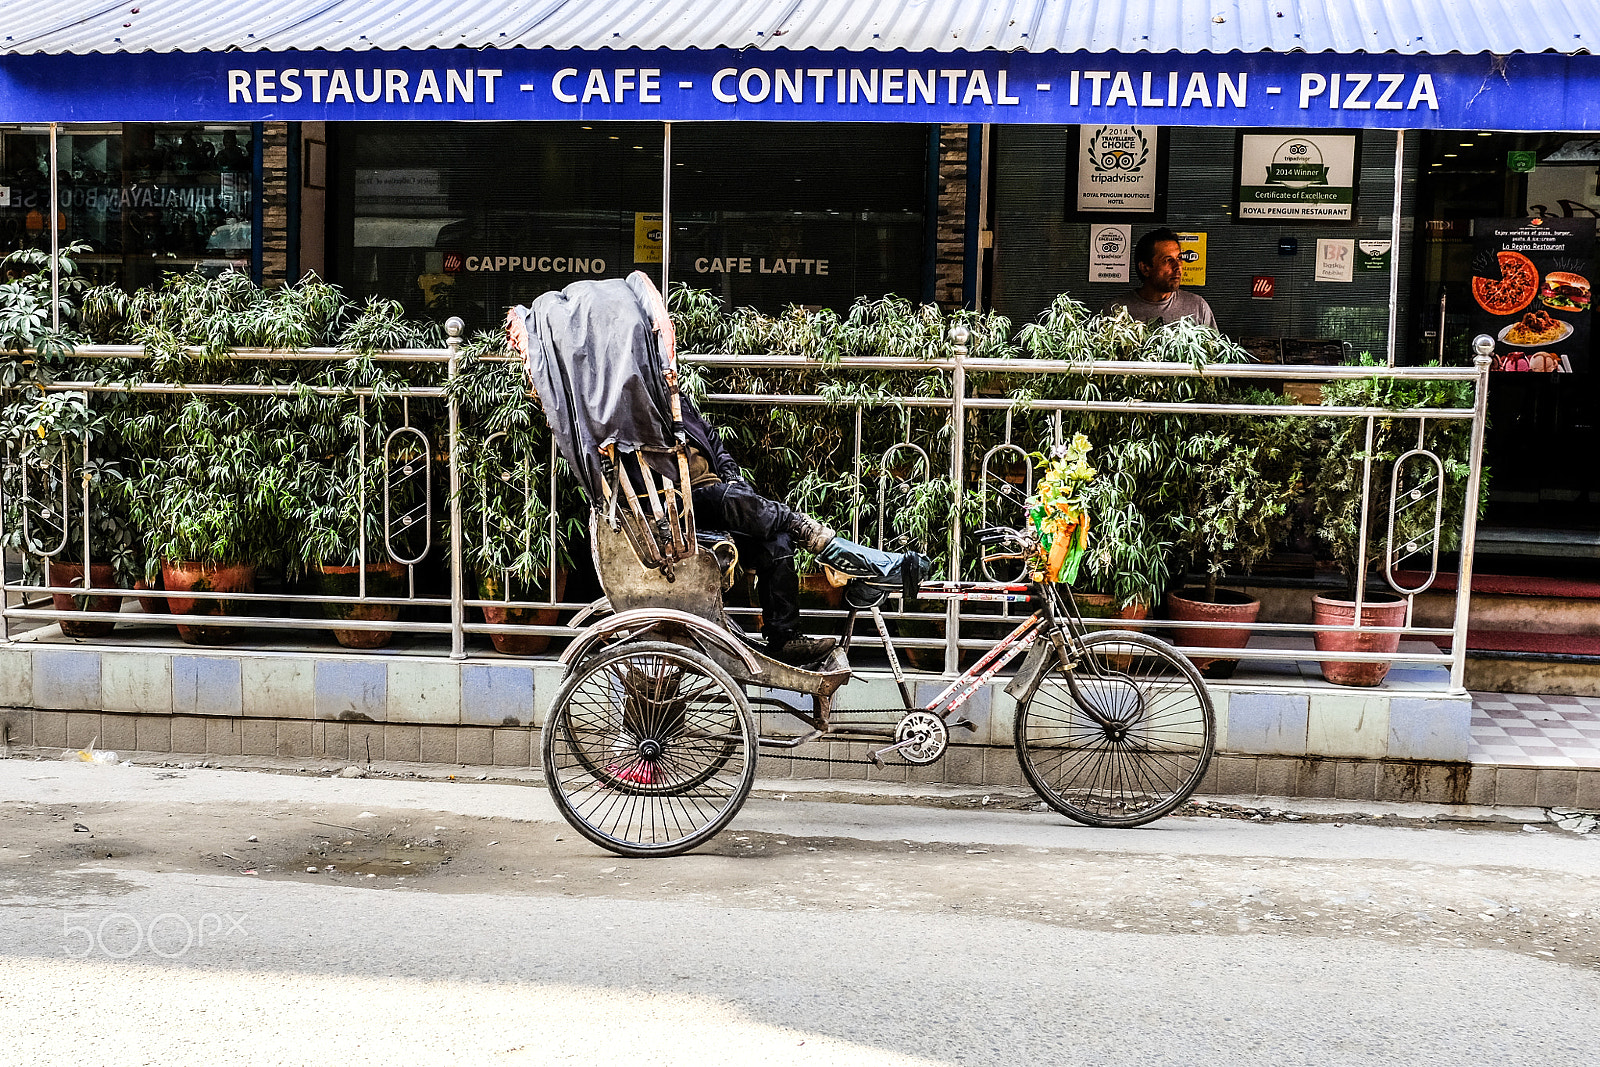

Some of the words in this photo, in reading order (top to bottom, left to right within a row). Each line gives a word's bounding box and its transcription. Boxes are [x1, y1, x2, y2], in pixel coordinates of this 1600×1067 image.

[228, 69, 503, 104] RESTAURANT
[551, 68, 662, 103] CAFE
[711, 68, 1019, 106] CONTINENTAL
[1069, 70, 1248, 108] ITALIAN
[1299, 72, 1440, 110] PIZZA
[1101, 141, 1136, 149] CHOICE
[1293, 168, 1319, 176] Winner
[1091, 173, 1141, 184] tripadvisor
[1255, 191, 1291, 199] Certificate
[1292, 191, 1300, 199] of
[1300, 191, 1338, 199] Excellence
[1267, 207, 1300, 215] PENGUIN
[1511, 243, 1531, 251] Regina
[444, 255, 461, 270] illy
[465, 256, 606, 273] CAPPUCCINO
[694, 257, 752, 274] CAFE
[759, 258, 829, 276] LATTE
[1253, 279, 1272, 295] illy
